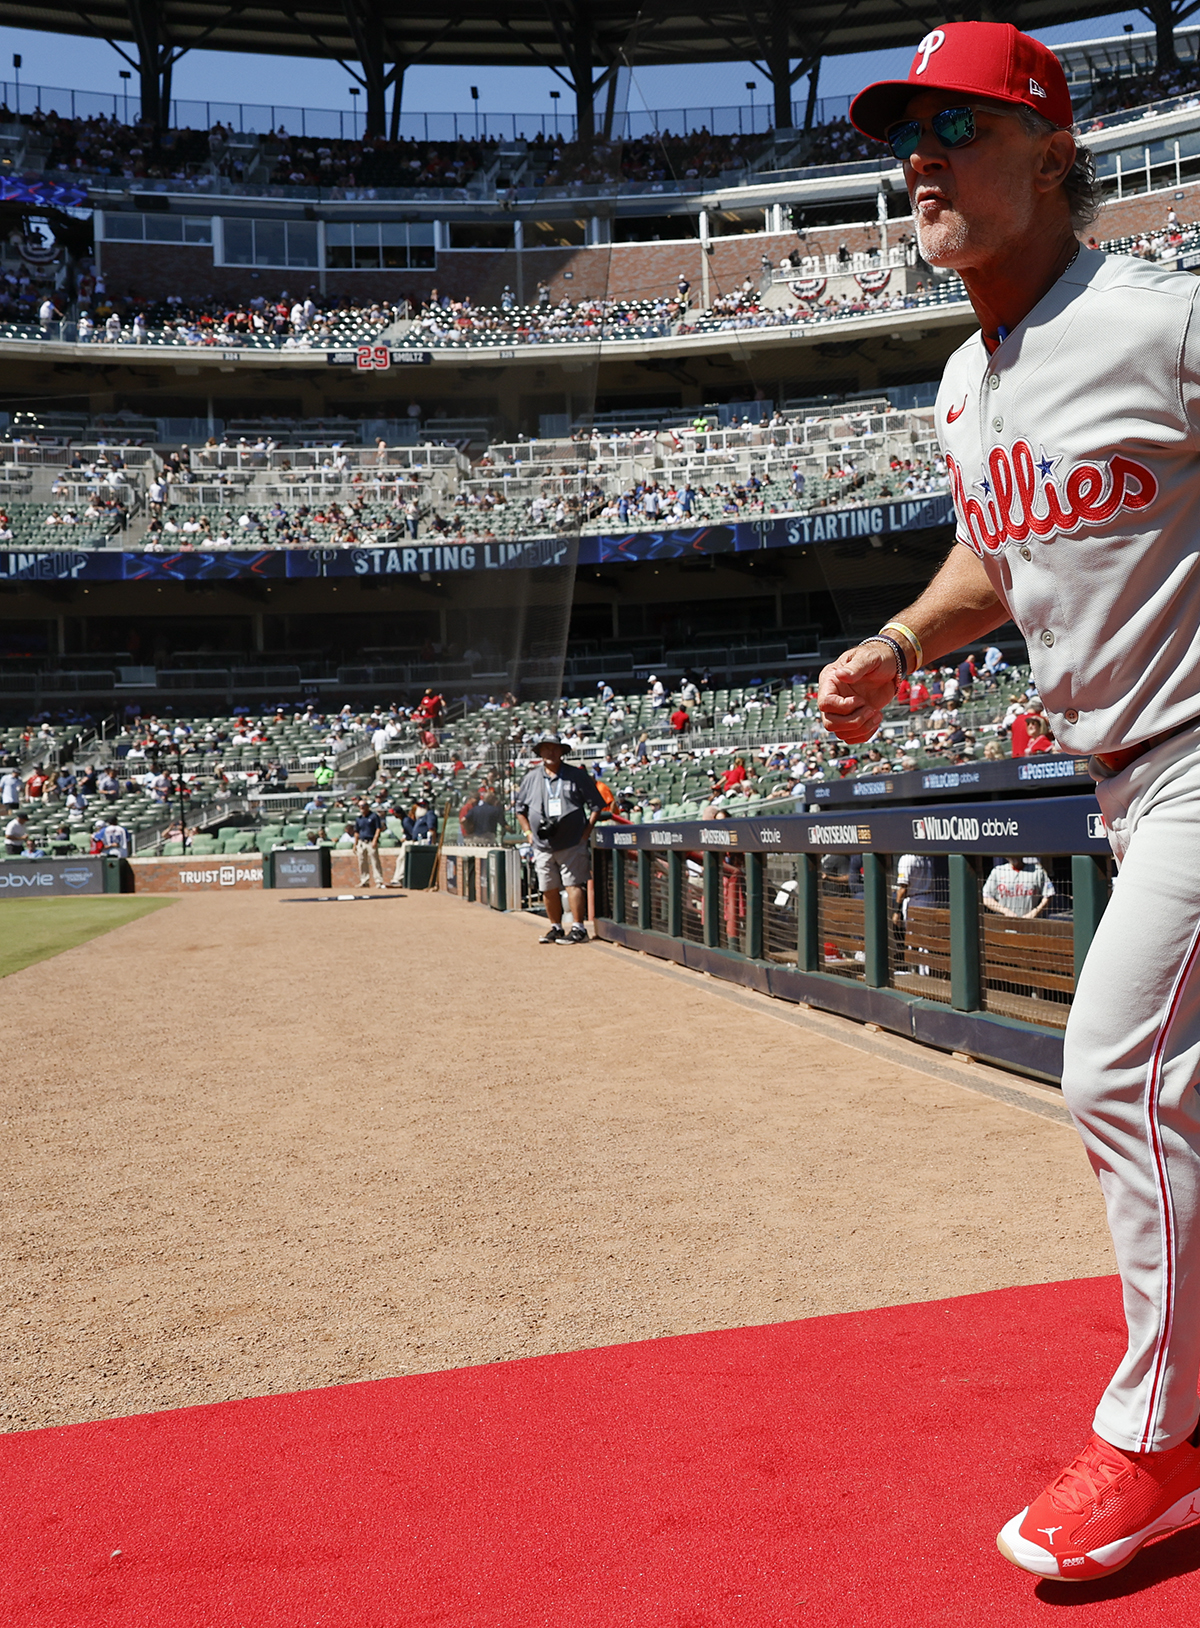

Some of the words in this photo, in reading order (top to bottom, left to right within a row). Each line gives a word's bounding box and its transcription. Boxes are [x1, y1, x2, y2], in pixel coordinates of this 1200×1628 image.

[915, 29, 946, 76] P
[780, 255, 821, 277] 221
[356, 346, 391, 370] 29
[392, 352, 424, 363] SMOLTZ
[785, 507, 883, 544] STARTING
[352, 545, 476, 575] STARTING
[484, 538, 569, 569] LINEUP
[1027, 760, 1074, 780] POSTSEASON
[703, 828, 730, 846] POSTSEASON
[760, 828, 781, 843] abbvie
[816, 824, 858, 844] POSTSEASON
[982, 817, 1019, 837] abbvie
[179, 870, 218, 884] TRUIST
[236, 869, 264, 882] PARK
